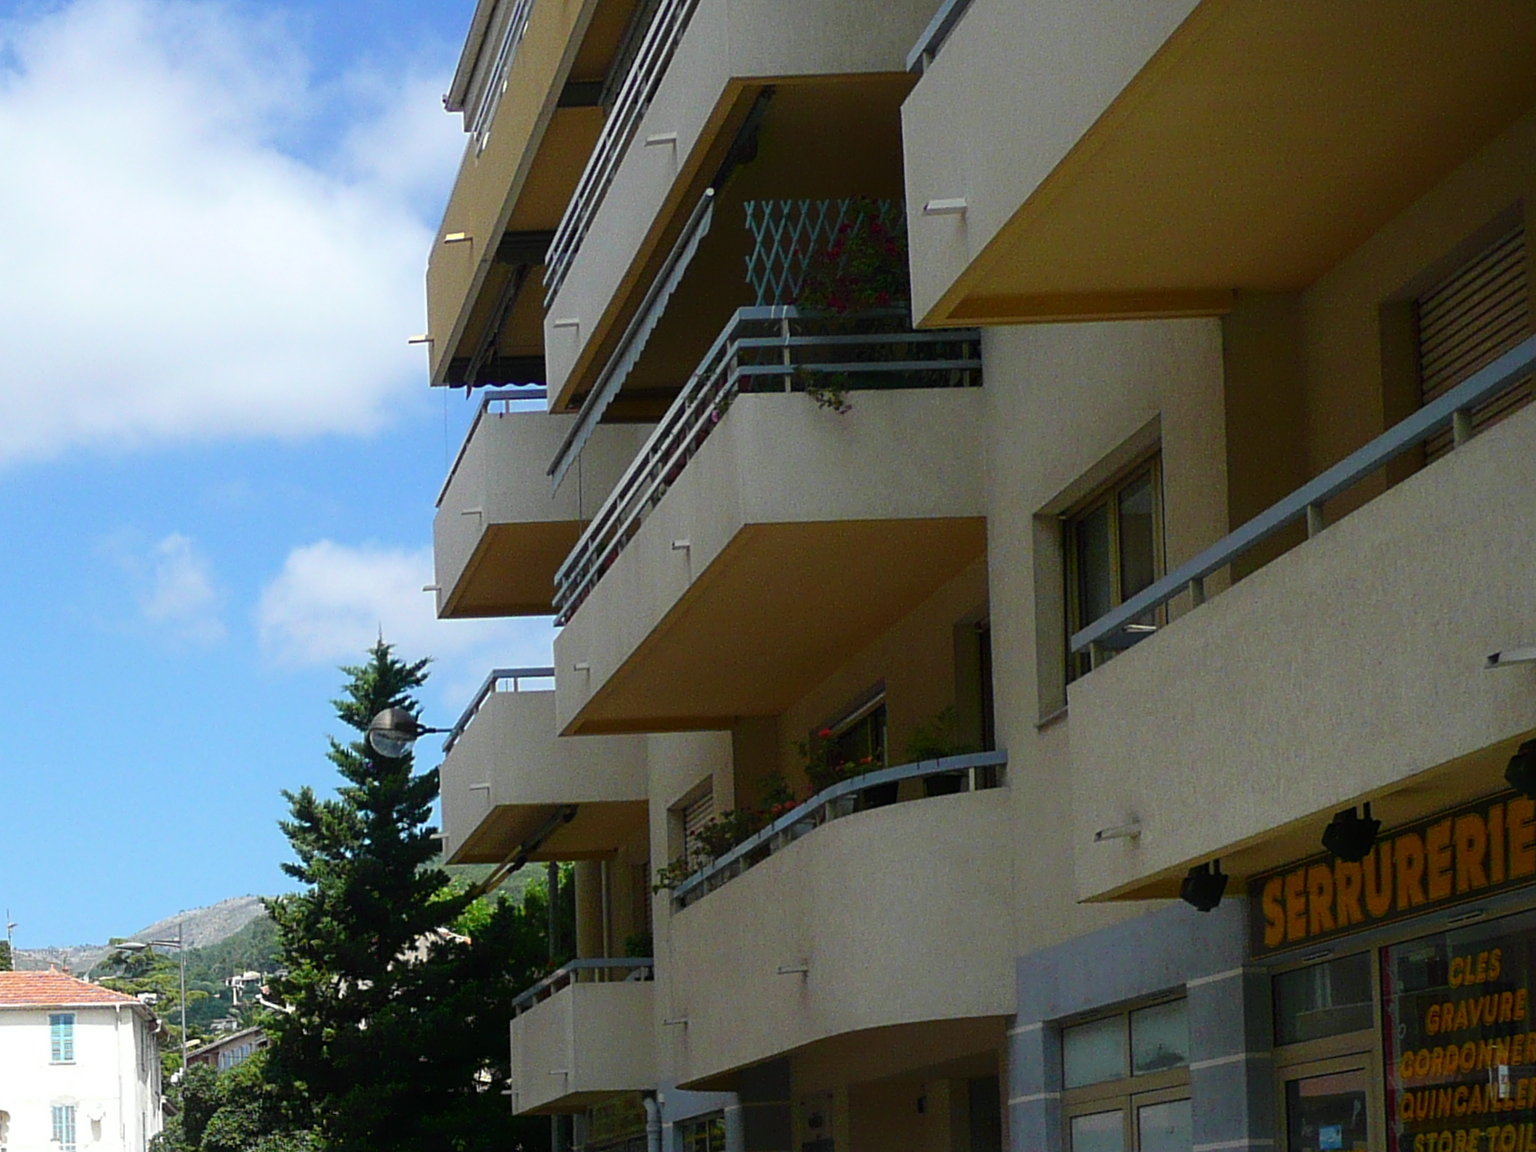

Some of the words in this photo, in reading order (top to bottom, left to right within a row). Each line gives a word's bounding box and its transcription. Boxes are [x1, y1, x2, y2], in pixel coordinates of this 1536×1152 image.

[1263, 795, 1536, 948] SERRURERIE
[1448, 949, 1502, 989] CLES
[1426, 988, 1528, 1036] GRAVURE
